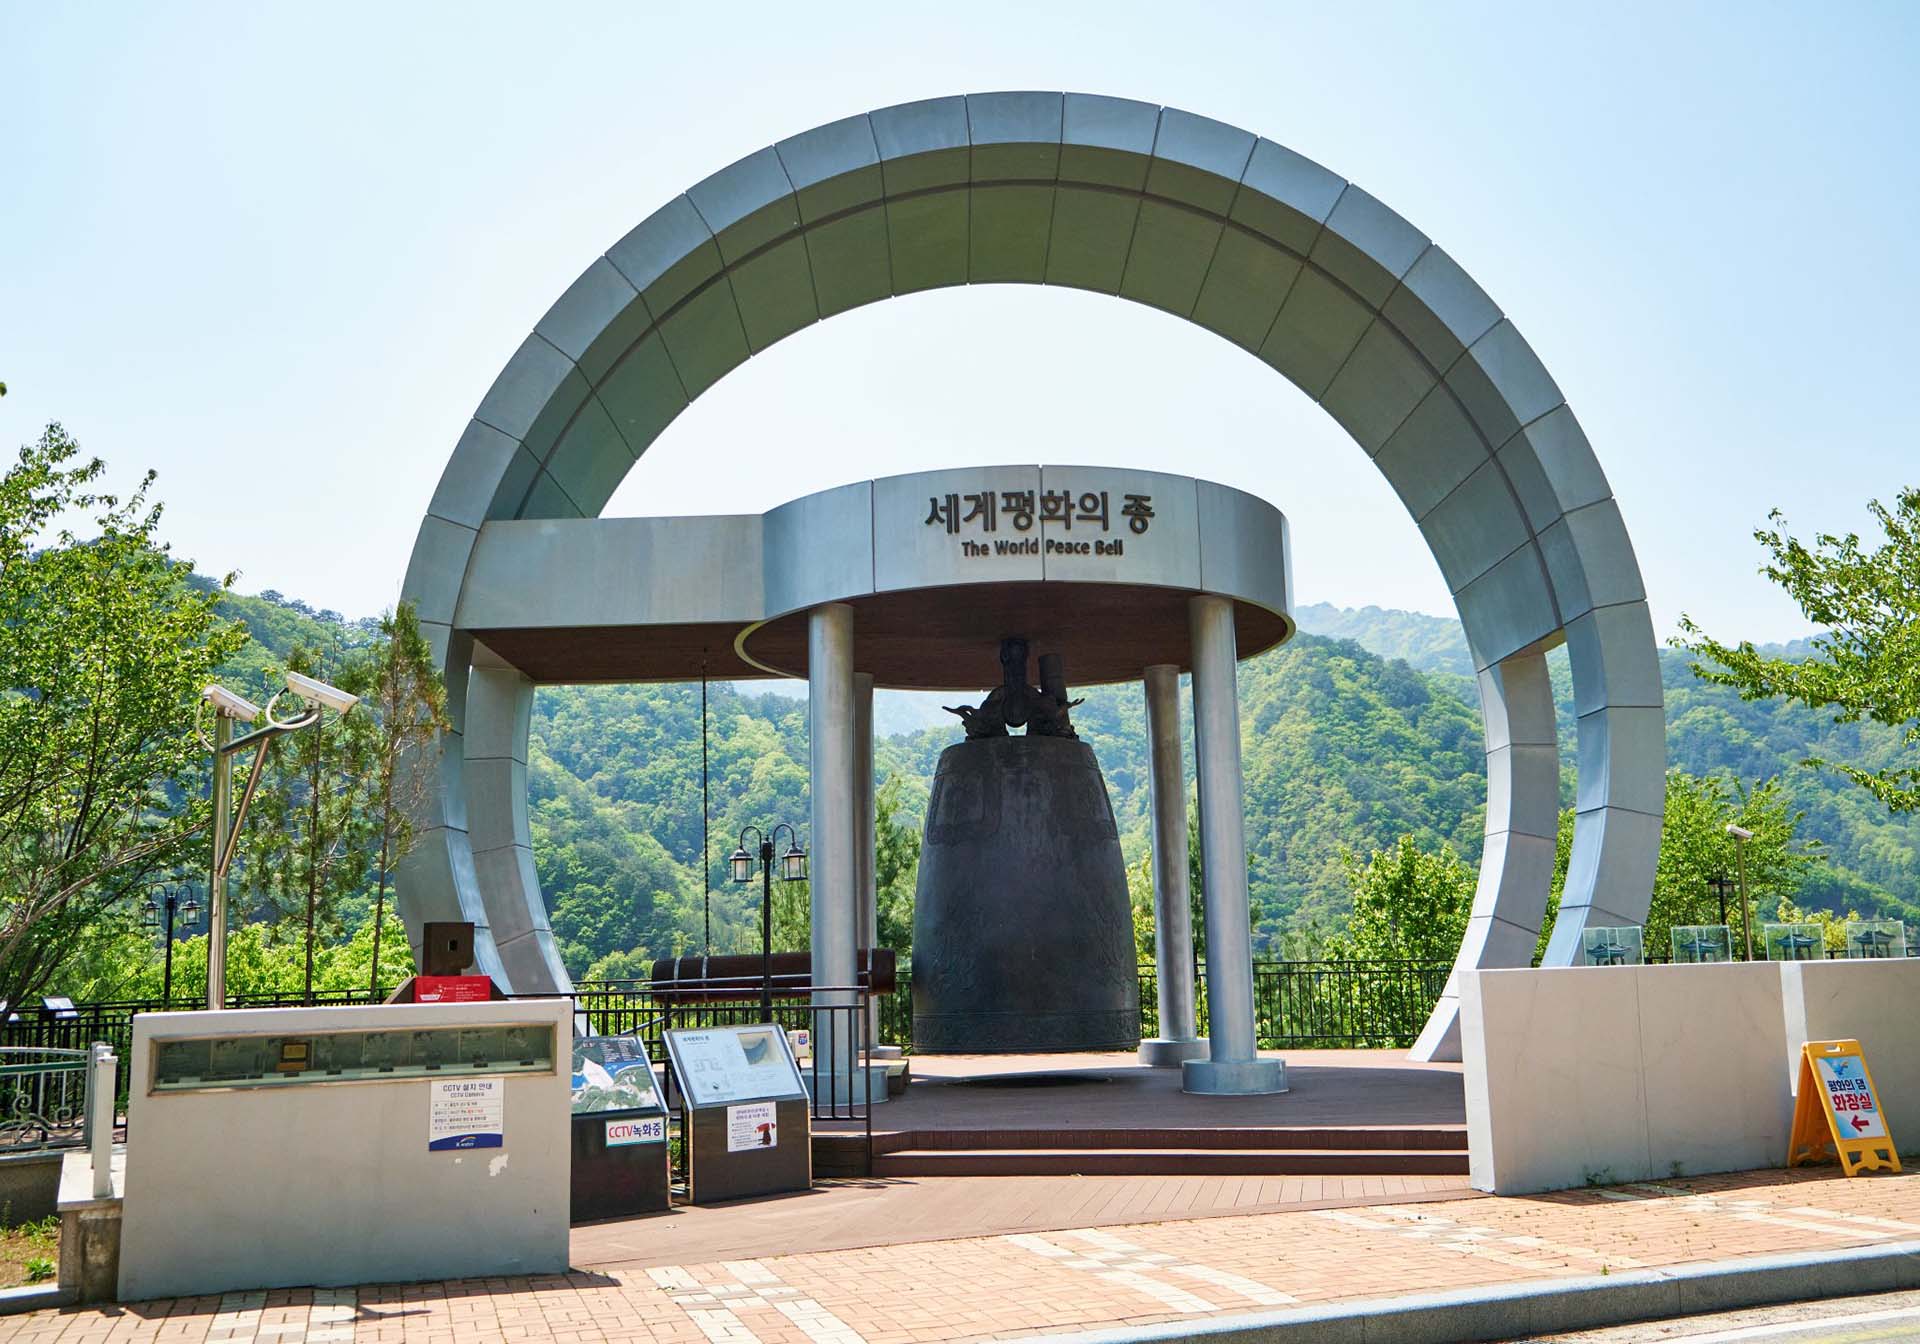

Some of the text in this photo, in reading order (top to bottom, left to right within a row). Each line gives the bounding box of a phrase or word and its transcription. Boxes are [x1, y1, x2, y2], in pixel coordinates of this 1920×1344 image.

[925, 490, 1155, 534] 세계평화의 종
[962, 537, 1124, 557] The World Peace Bell
[443, 1084, 461, 1092] CCTV
[479, 1082, 492, 1090] 안내
[1827, 1078, 1867, 1092] 평화의 댐
[1832, 1092, 1873, 1111] 화장실
[608, 1122, 662, 1138] CCTV녹화중
